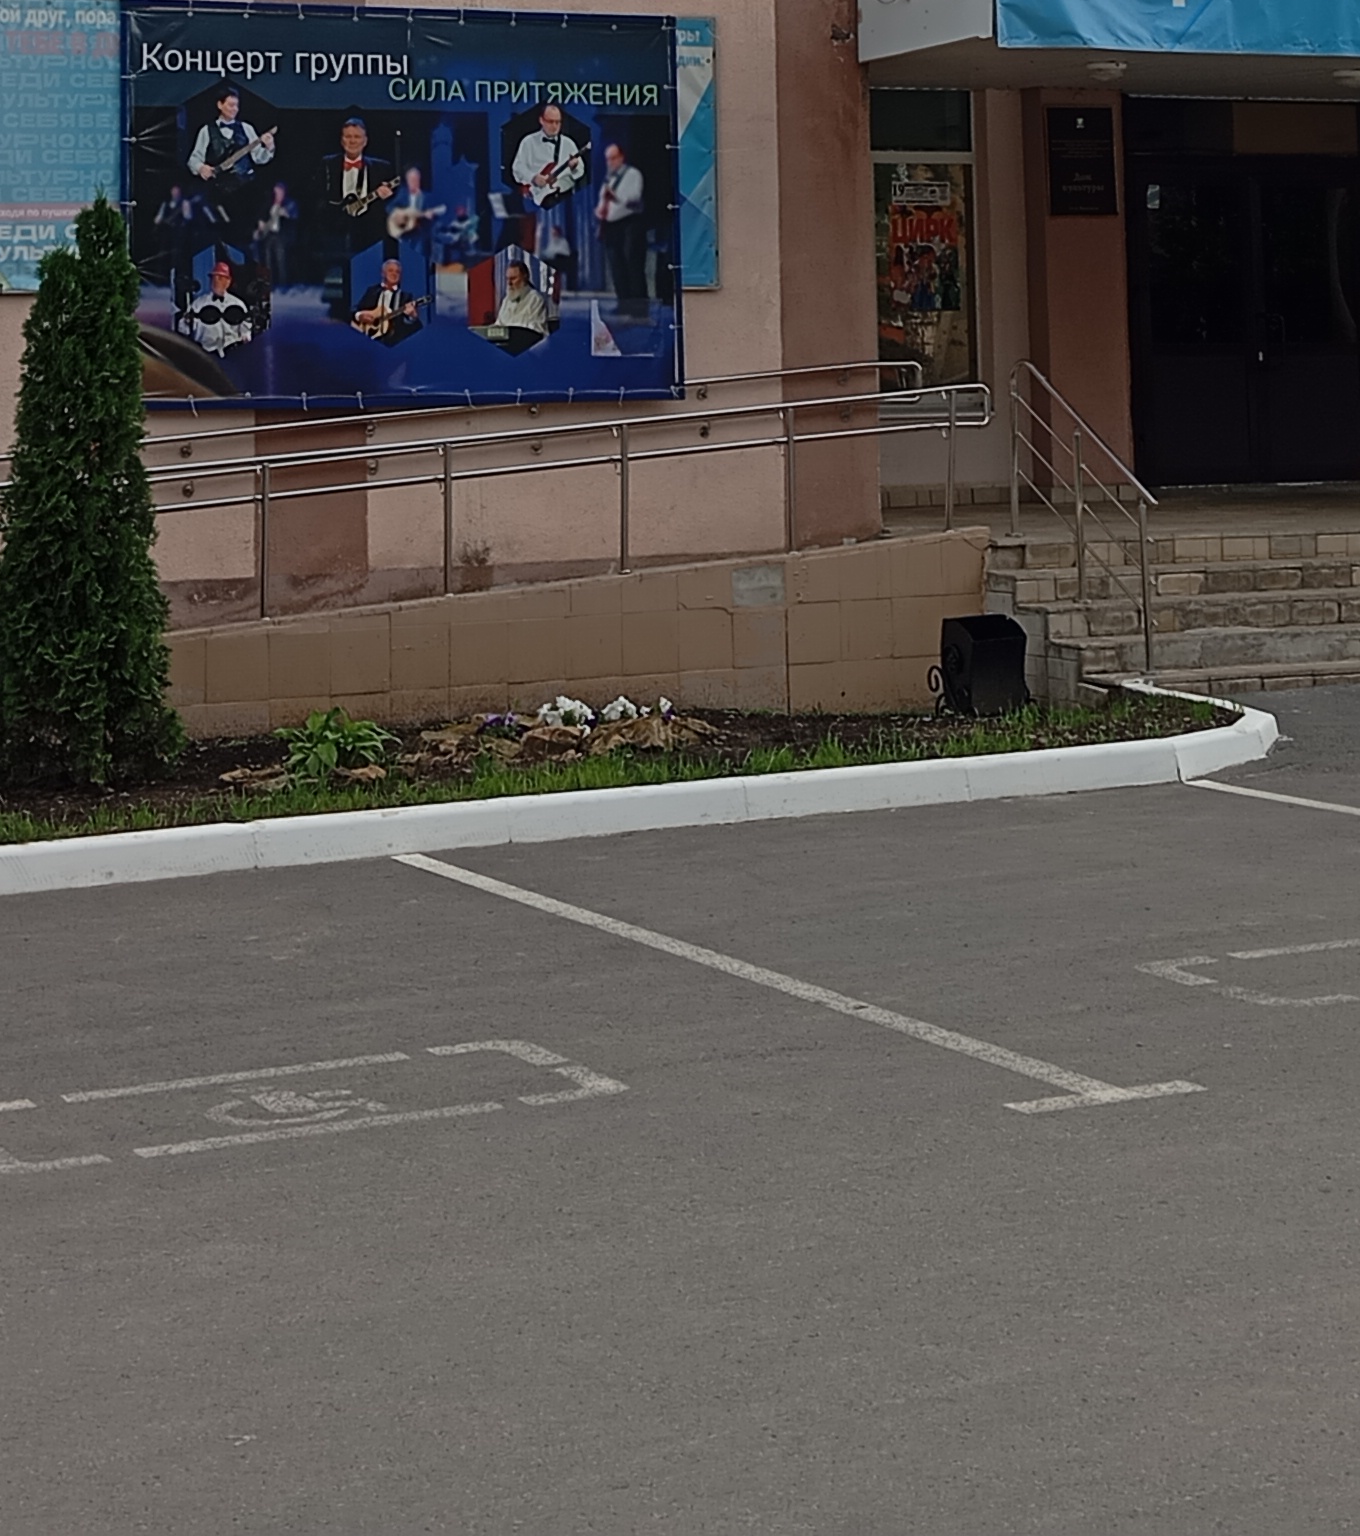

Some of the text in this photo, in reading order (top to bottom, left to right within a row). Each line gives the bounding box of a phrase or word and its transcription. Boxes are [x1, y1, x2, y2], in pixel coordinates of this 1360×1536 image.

[25, 9, 71, 28] друг,
[5, 30, 64, 53] ТЕБЕ
[141, 43, 410, 83] Концерт группы
[388, 77, 659, 107] СИЛА ПРИТЯЖЕНИЯ
[892, 217, 958, 244] ЦИРК
